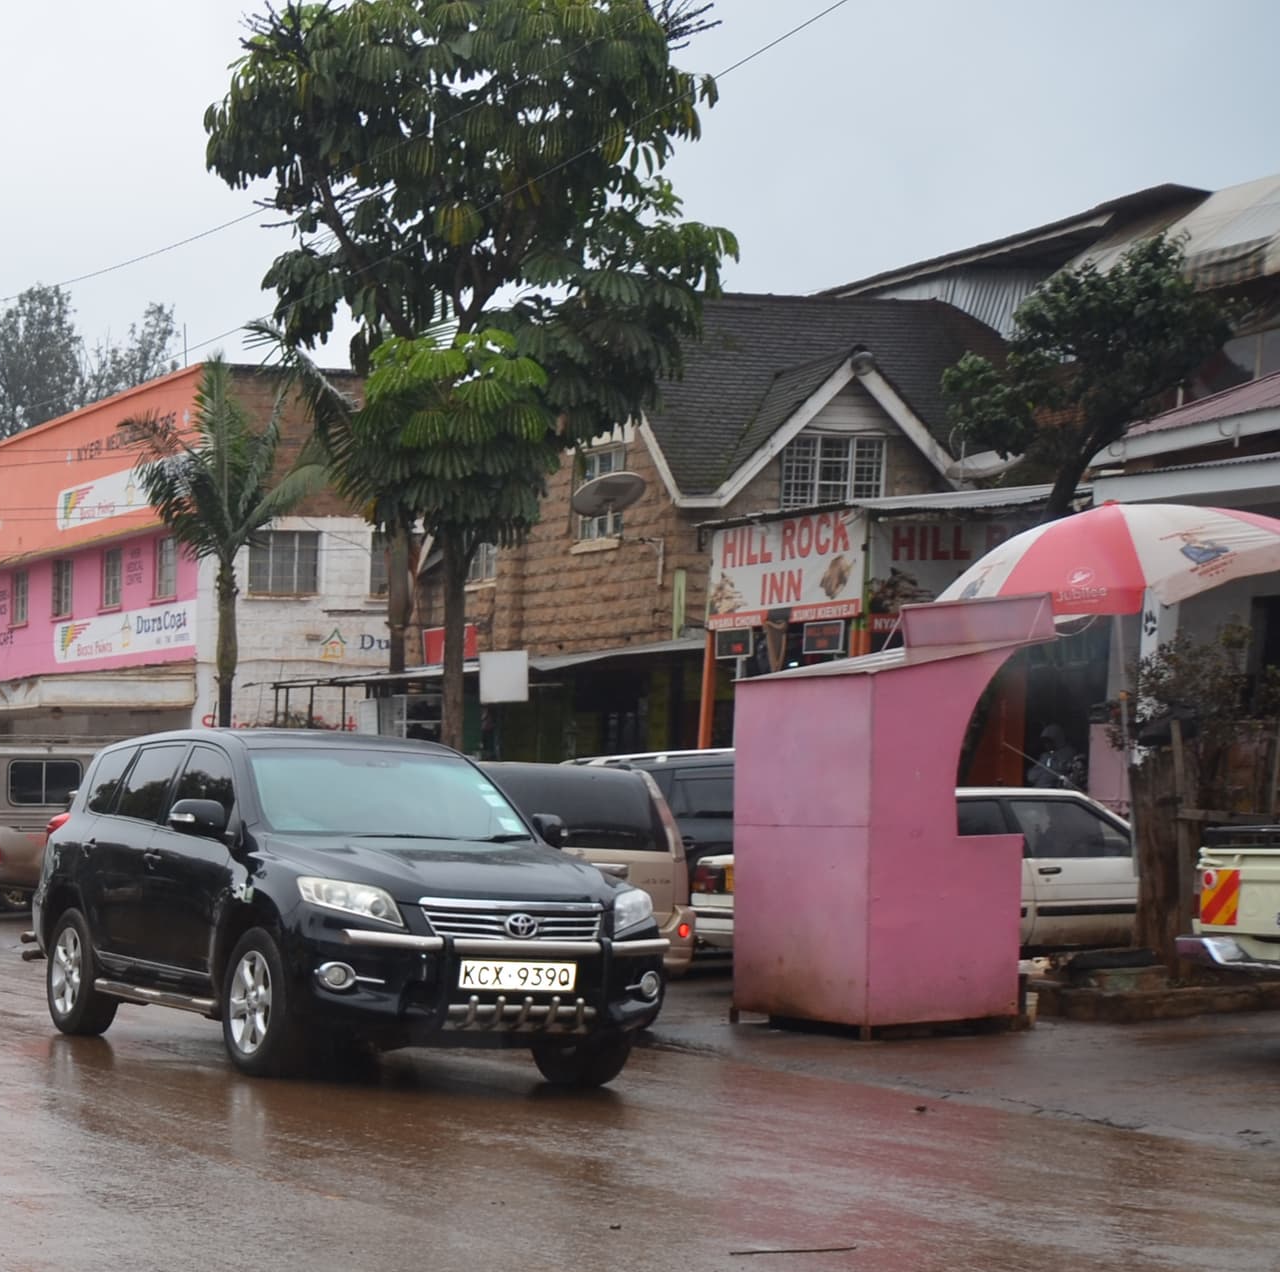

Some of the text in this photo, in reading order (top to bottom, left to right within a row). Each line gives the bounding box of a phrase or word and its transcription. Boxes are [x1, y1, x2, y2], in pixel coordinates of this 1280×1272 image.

[722, 508, 850, 569] HILL ROCK
[892, 525, 972, 561] HILL
[760, 568, 803, 606] INN
[463, 965, 570, 986] KCX 939Q
